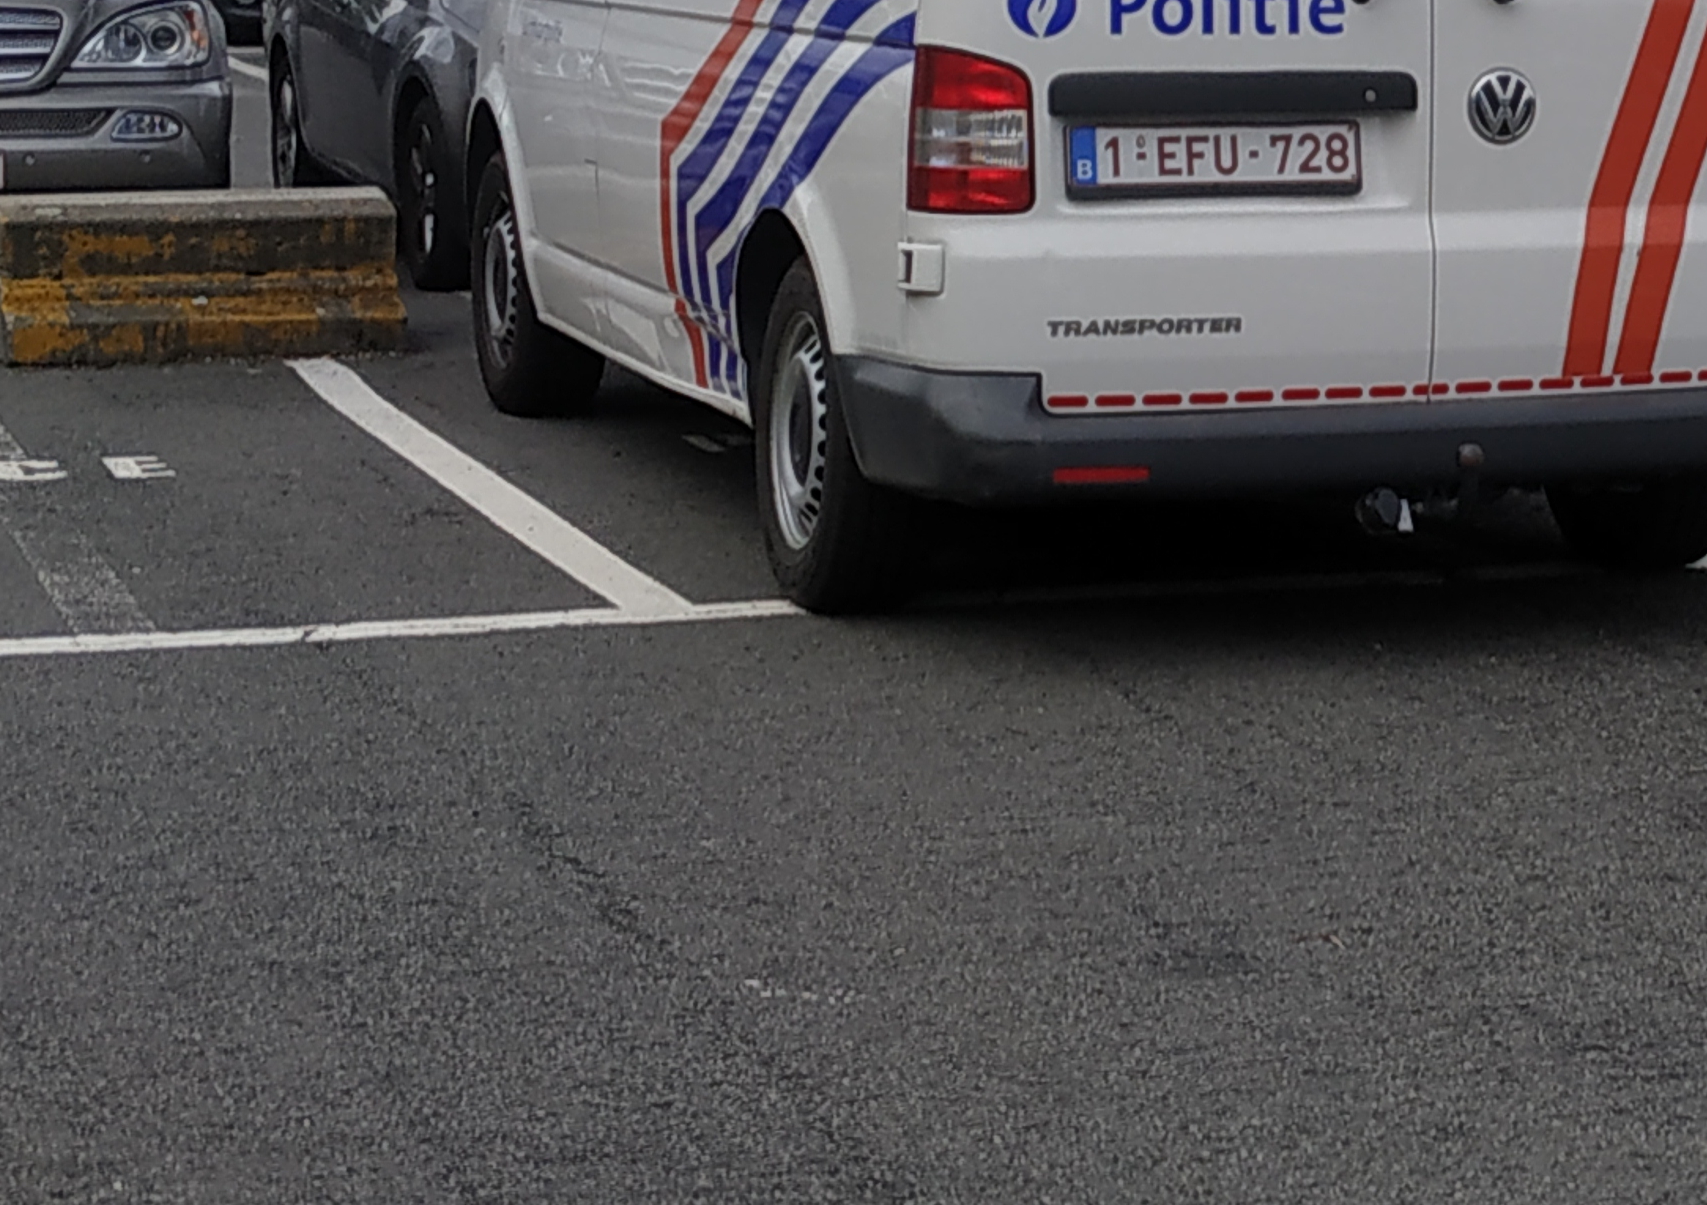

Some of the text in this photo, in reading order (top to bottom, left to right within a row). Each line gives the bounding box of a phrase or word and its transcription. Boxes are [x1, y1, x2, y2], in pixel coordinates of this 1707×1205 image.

[1076, 132, 1350, 180] B 1-EFU-728
[1047, 316, 1242, 337] TRANSPORTER
